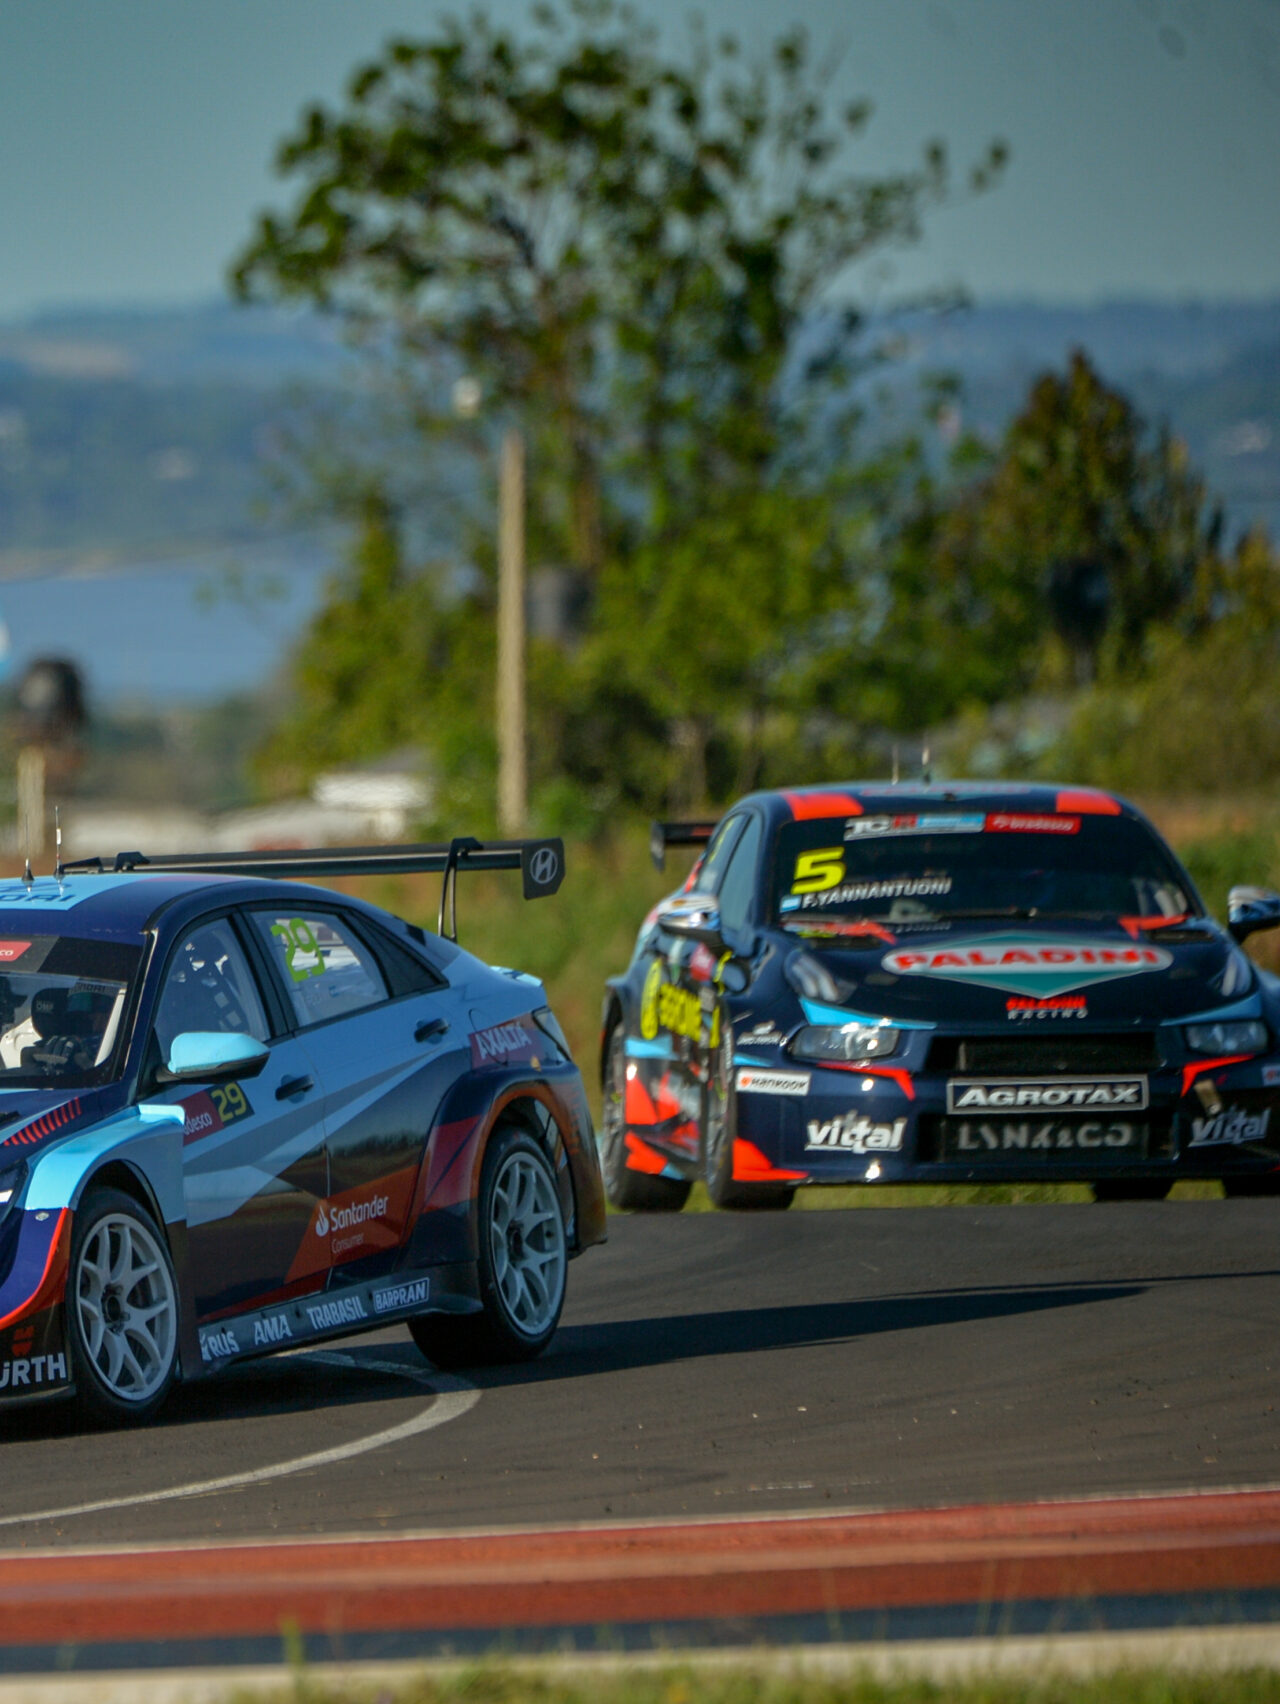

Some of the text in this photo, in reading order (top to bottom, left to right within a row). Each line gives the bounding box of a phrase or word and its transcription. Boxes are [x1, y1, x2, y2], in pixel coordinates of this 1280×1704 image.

[791, 846, 846, 894] 5
[270, 917, 325, 983] 29
[894, 948, 1159, 971] PALADINI
[475, 1022, 532, 1060] AXALTA
[210, 1082, 247, 1123] 29
[956, 1083, 1140, 1107] AGROTAX
[330, 1195, 389, 1232] Santander
[254, 1314, 293, 1345] AMA
[306, 1296, 368, 1330] TRABASIL
